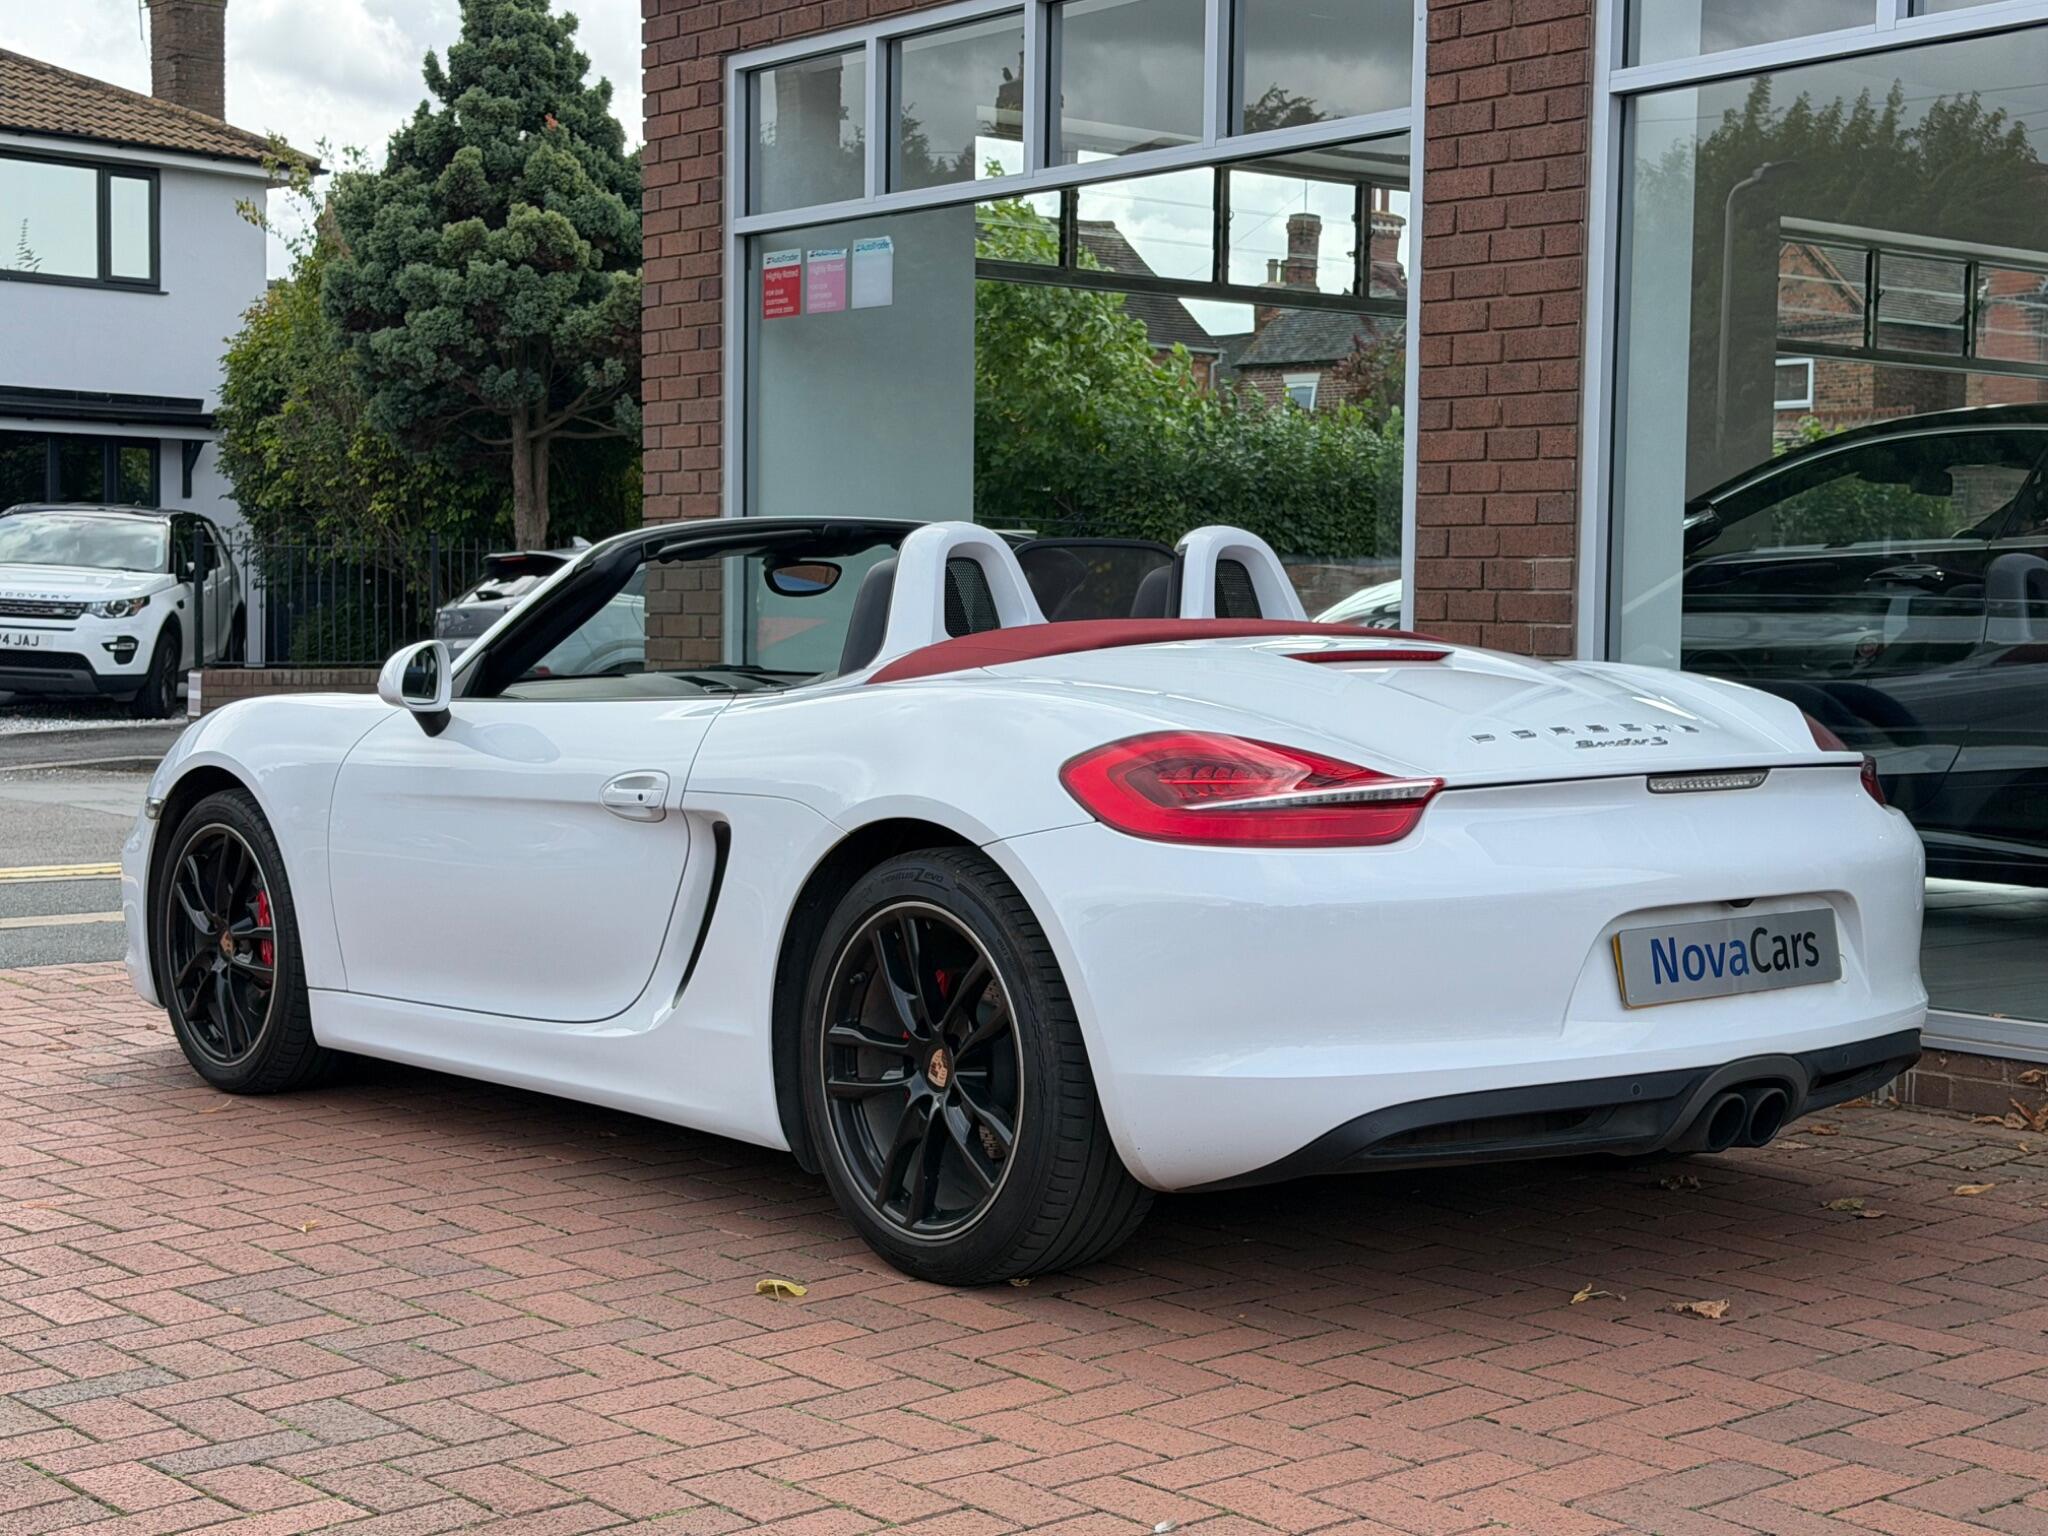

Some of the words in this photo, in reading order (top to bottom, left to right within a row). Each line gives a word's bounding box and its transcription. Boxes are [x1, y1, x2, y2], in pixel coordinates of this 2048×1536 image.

[0, 591, 71, 599] COVERY
[14, 634, 39, 647] JAJ
[1469, 723, 1700, 743] PORSCHE
[1650, 926, 1820, 984] NovaCars
